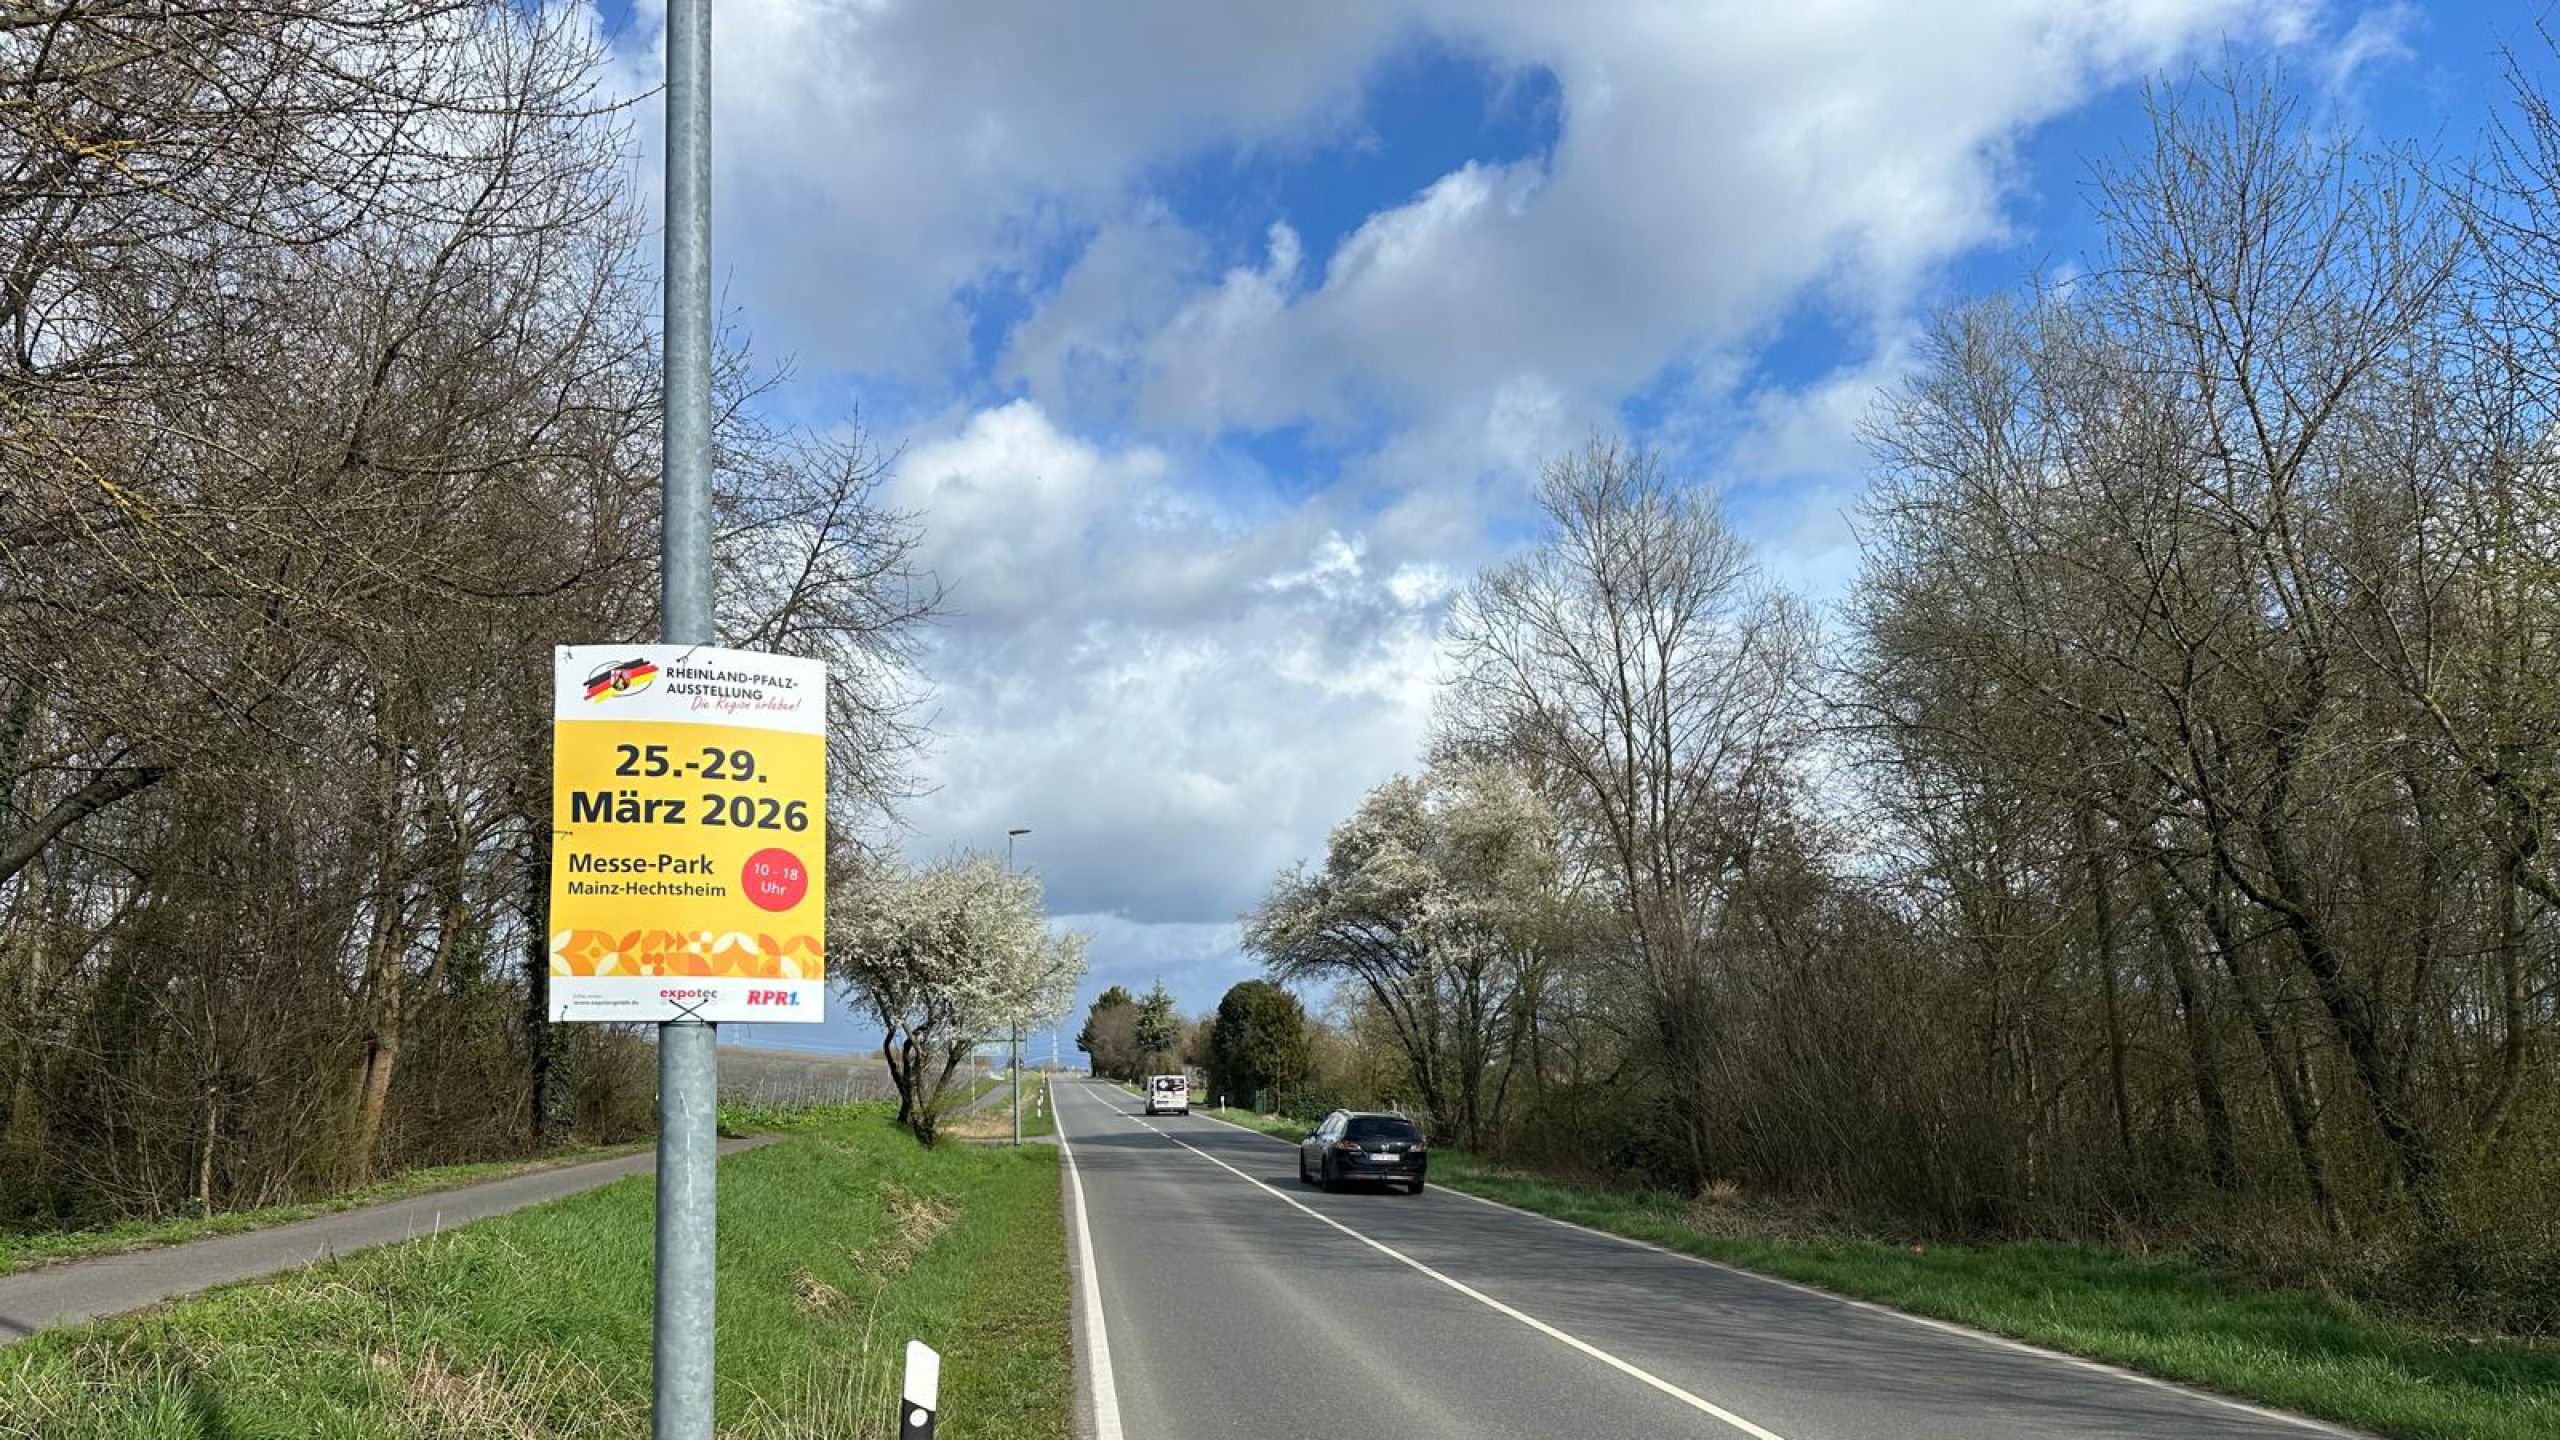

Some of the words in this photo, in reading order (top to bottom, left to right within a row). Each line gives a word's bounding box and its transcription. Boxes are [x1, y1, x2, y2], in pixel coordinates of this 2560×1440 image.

[666, 667, 799, 690] RHEINLAND-PFALZ-
[666, 684, 763, 701] AUSSTELLUNG
[691, 697, 710, 712] Die
[715, 697, 751, 715] Region
[754, 697, 802, 713] erleben!
[615, 744, 768, 784] 25.-29.
[571, 790, 686, 825] März
[701, 793, 809, 832] 2026
[568, 853, 715, 875] Messe-Park
[754, 863, 769, 877] 10
[783, 867, 799, 881] 18
[568, 881, 727, 897] Mainz-Hechtsheim
[761, 882, 787, 897] Uhr
[660, 988, 718, 1000] expotec
